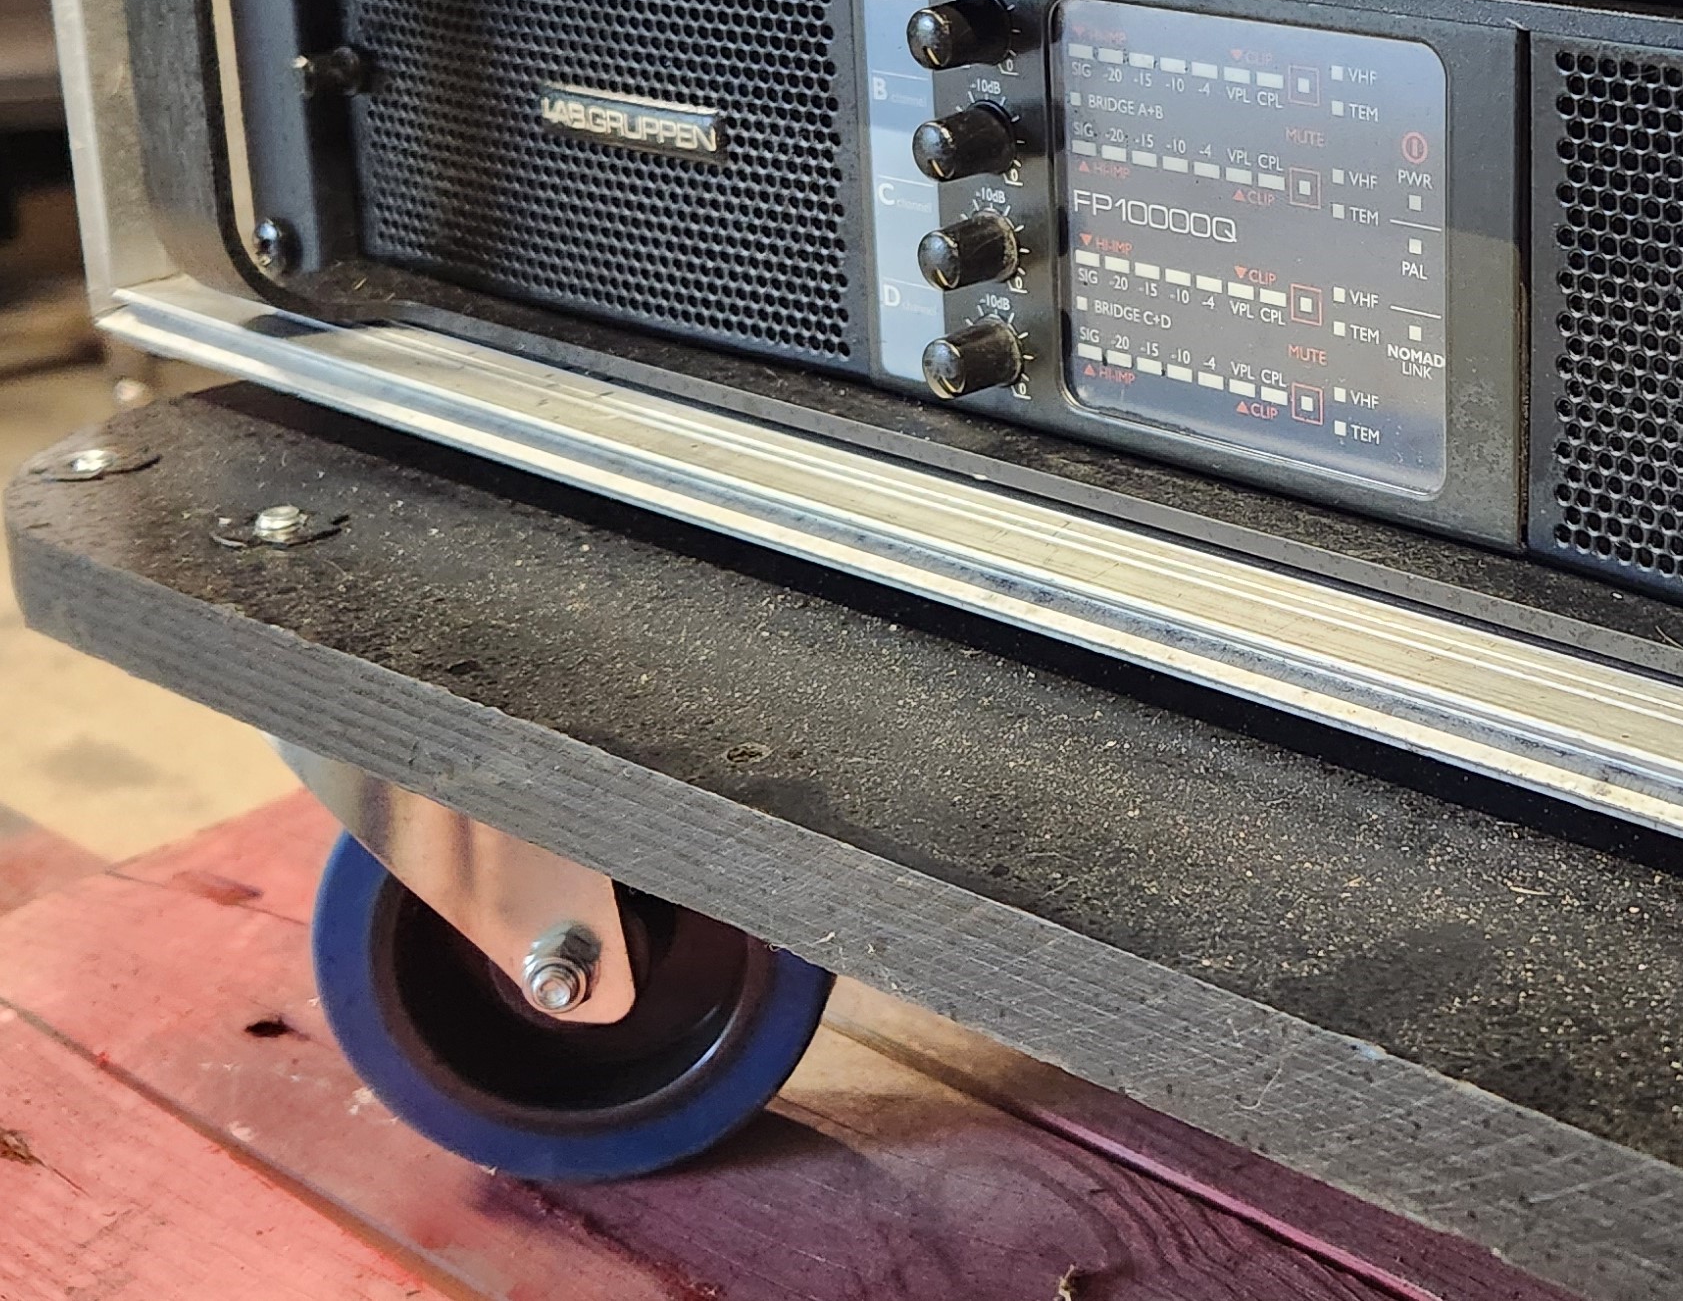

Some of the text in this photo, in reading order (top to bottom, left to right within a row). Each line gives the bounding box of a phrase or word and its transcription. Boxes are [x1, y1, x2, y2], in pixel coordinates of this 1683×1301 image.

[1245, 50, 1273, 63] CLIP
[970, 78, 1001, 95] -10dB
[1071, 62, 1283, 109] SIG -20 -15 -10 -4 VPL CPL
[1348, 67, 1377, 86] VHF
[873, 77, 888, 100] B
[1088, 94, 1163, 119] BRIDGE A+B
[1349, 103, 1379, 122] TEM
[1074, 122, 1284, 171] SIG -20 -15 -10 -4 VPL CPL
[1285, 126, 1325, 148] MUTE
[1349, 171, 1378, 190] VHF
[1398, 169, 1433, 190] PWR
[878, 183, 895, 206] C
[975, 187, 1006, 204] -10dB
[1247, 190, 1275, 206] CLIP
[1073, 189, 1237, 243] FP10000Q
[1349, 206, 1379, 226] TEM
[1249, 269, 1276, 285] CLIP
[1402, 260, 1428, 280] PAL
[883, 285, 900, 308] D
[980, 294, 1011, 311] -10dB
[1078, 268, 1286, 325] SIG -20 -15 -10 -4 VPL CPL
[1349, 289, 1379, 309] VHF
[1094, 300, 1172, 329] BRIDGE C+D
[1350, 324, 1380, 345] TEM
[1079, 326, 1287, 388] SIG -20 -15 -10 -4 VPL CPL
[1288, 344, 1328, 366] MUTE
[1387, 343, 1445, 368] NOMAD
[1099, 367, 1136, 385] HI-IMP
[1402, 361, 1433, 380] LINK
[1350, 389, 1379, 409] VHF
[1250, 403, 1278, 420] CLIP
[1350, 424, 1380, 445] TEM
